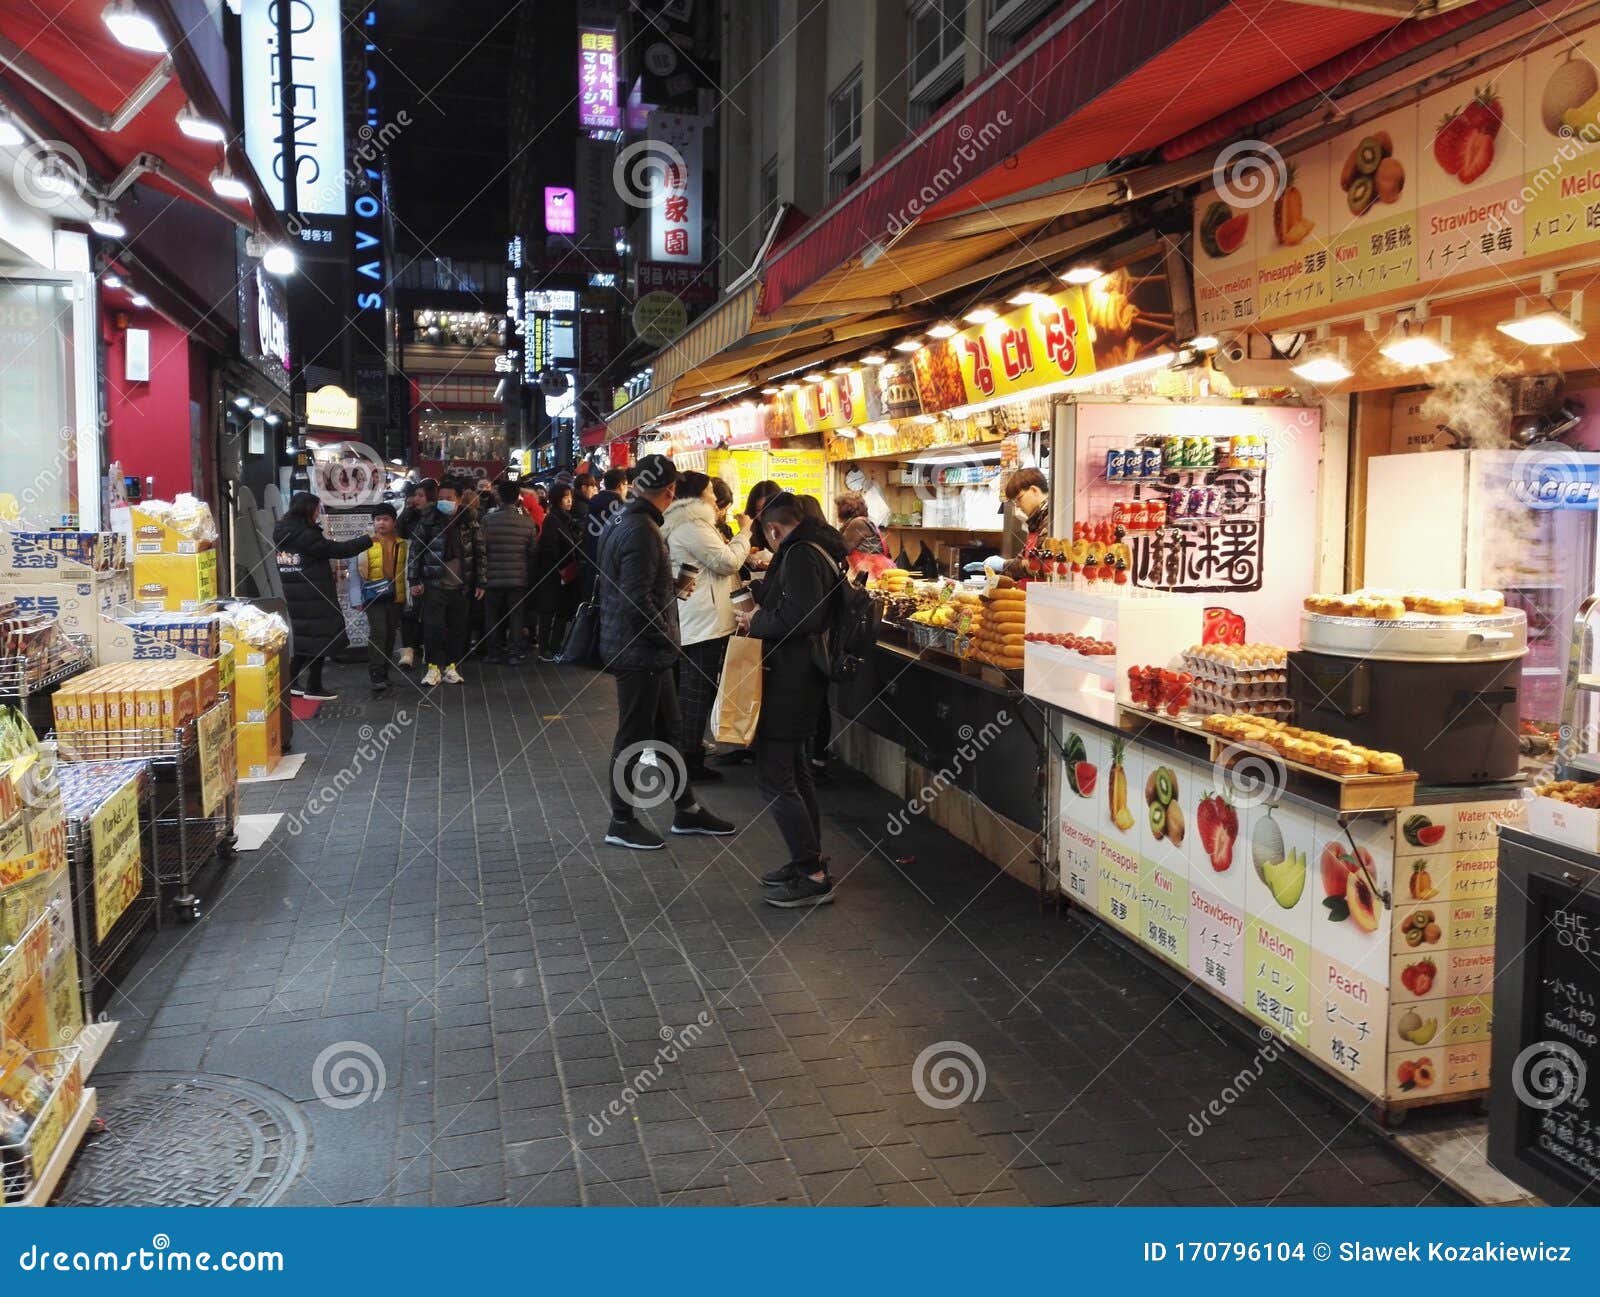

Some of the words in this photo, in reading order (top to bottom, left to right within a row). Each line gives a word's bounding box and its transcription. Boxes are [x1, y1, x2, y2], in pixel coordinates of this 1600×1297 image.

[600, 52, 615, 106] 마사지
[1430, 200, 1508, 236] Strawberry
[1530, 212, 1578, 245] メロン
[300, 229, 333, 242] 명동점
[1425, 239, 1471, 271] イチゴ
[1480, 226, 1513, 257] 草莓
[1335, 241, 1359, 262] Kiwi
[1224, 276, 1251, 294] melon
[1257, 259, 1303, 286] Pineapple
[1233, 297, 1253, 319] 西瓜
[964, 306, 1079, 396] 김대장
[1457, 810, 1487, 823] Water
[1456, 830, 1490, 845] すいか
[1100, 841, 1138, 874] Pineapple
[1455, 859, 1498, 873] Pineapp
[1070, 871, 1087, 896] 西瓜
[1154, 869, 1175, 893] Kiwi
[1191, 890, 1244, 937] Strawberry
[1453, 908, 1476, 921] Kiwi
[1199, 927, 1234, 958] イチゴ
[1258, 927, 1294, 963] Melon
[1453, 925, 1495, 941] キウイフ
[1204, 956, 1227, 988] 草莓
[1256, 962, 1296, 993] メロン
[1328, 965, 1369, 1004] Peach
[1451, 973, 1485, 990] イチゴ
[1256, 989, 1297, 1034] 哈密瓜
[1450, 1004, 1482, 1018] Melon
[1330, 1034, 1362, 1072] 桃子
[1449, 1053, 1478, 1066] Peach
